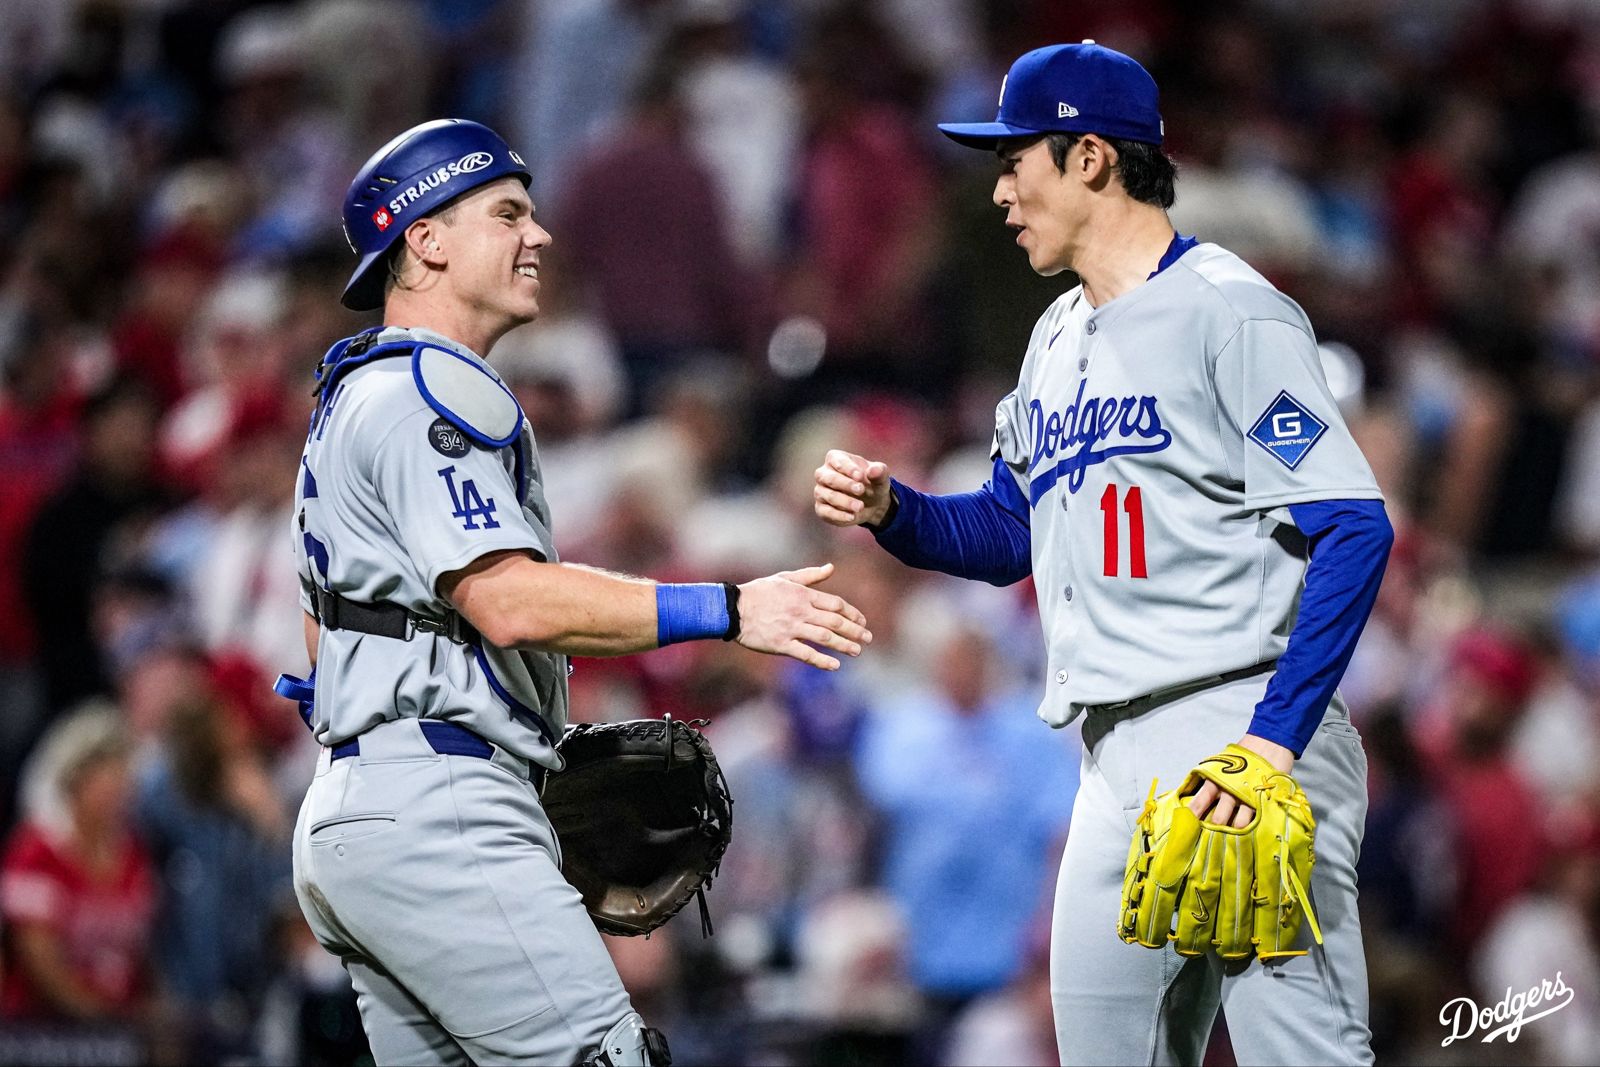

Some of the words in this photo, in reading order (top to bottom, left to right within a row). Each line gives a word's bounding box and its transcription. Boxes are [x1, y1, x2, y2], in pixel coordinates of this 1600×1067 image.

[438, 431, 465, 451] 34
[1029, 378, 1172, 509] Dodgers
[1267, 438, 1311, 447] GUGGENHEIM
[1272, 411, 1302, 438] G
[437, 465, 501, 531] LA
[1100, 483, 1148, 579] 11
